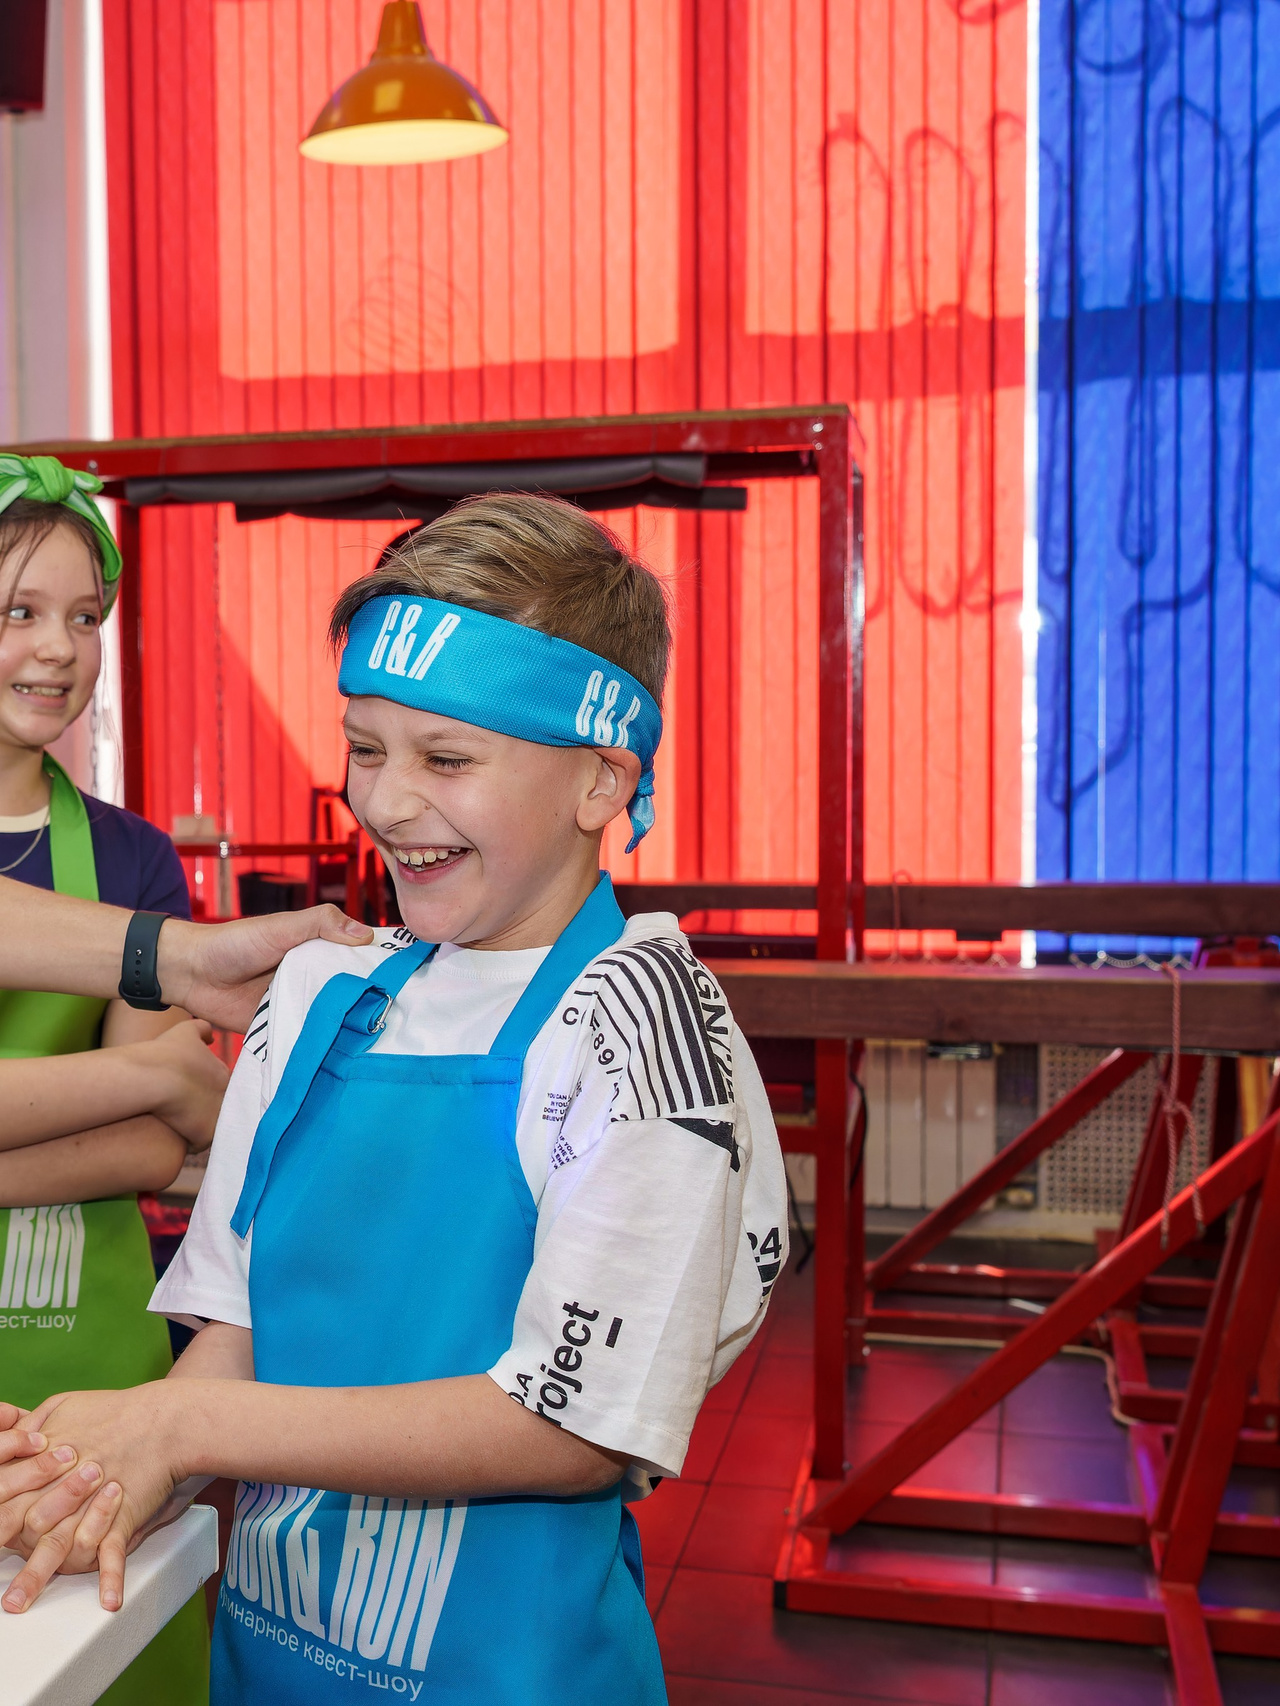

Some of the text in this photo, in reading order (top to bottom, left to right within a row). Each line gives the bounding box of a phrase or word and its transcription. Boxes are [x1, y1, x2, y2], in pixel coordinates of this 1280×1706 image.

[369, 600, 461, 681] C&R
[534, 1301, 600, 1428] roject
[328, 1494, 469, 1672] RUN
[303, 1640, 424, 1702] квест-шоу
